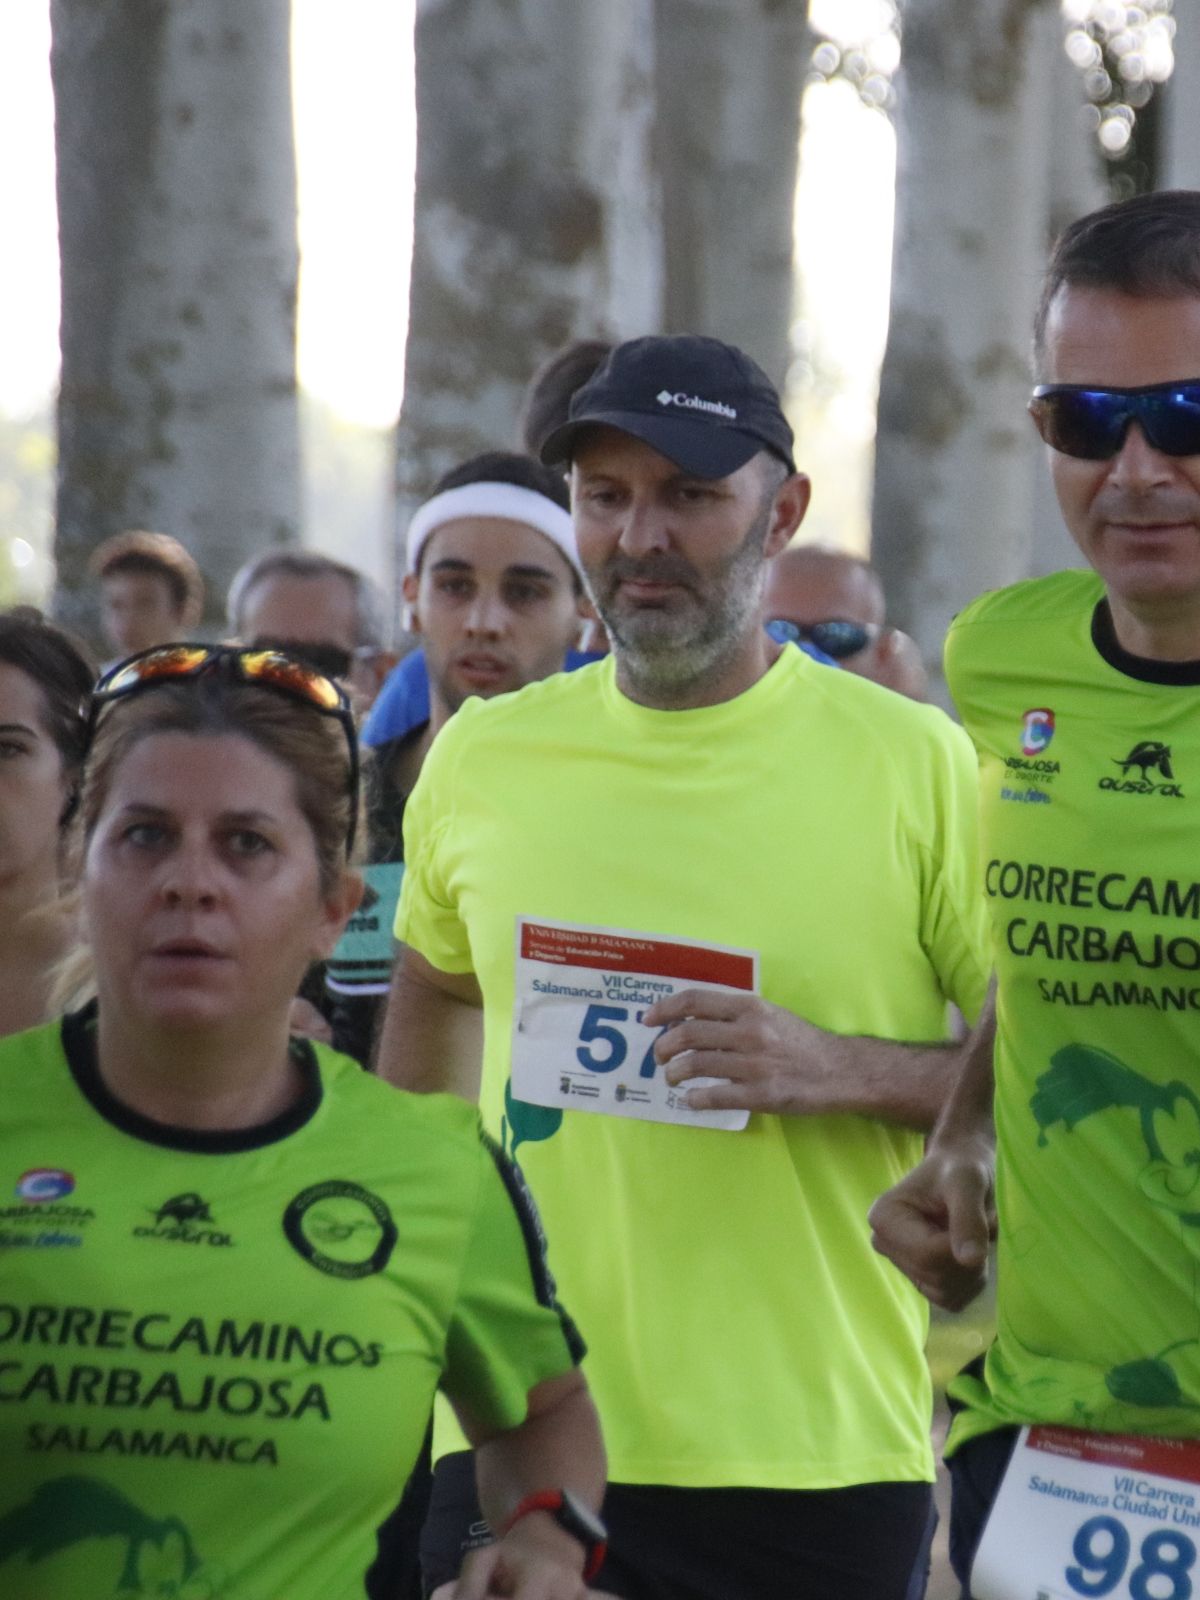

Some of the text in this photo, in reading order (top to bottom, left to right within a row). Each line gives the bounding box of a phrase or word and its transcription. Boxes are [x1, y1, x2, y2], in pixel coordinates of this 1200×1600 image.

[673, 392, 737, 419] Columbia
[532, 979, 603, 999] Salamanca
[606, 989, 654, 1005] Ciudad
[602, 974, 674, 994] VII Carrera
[26, 1422, 279, 1467] SALAMANCA
[1028, 1476, 1109, 1508] Salamanca
[1112, 1494, 1169, 1523] Ciudad
[1113, 1475, 1196, 1508] VII Carrera
[1065, 1514, 1197, 1600] 98
